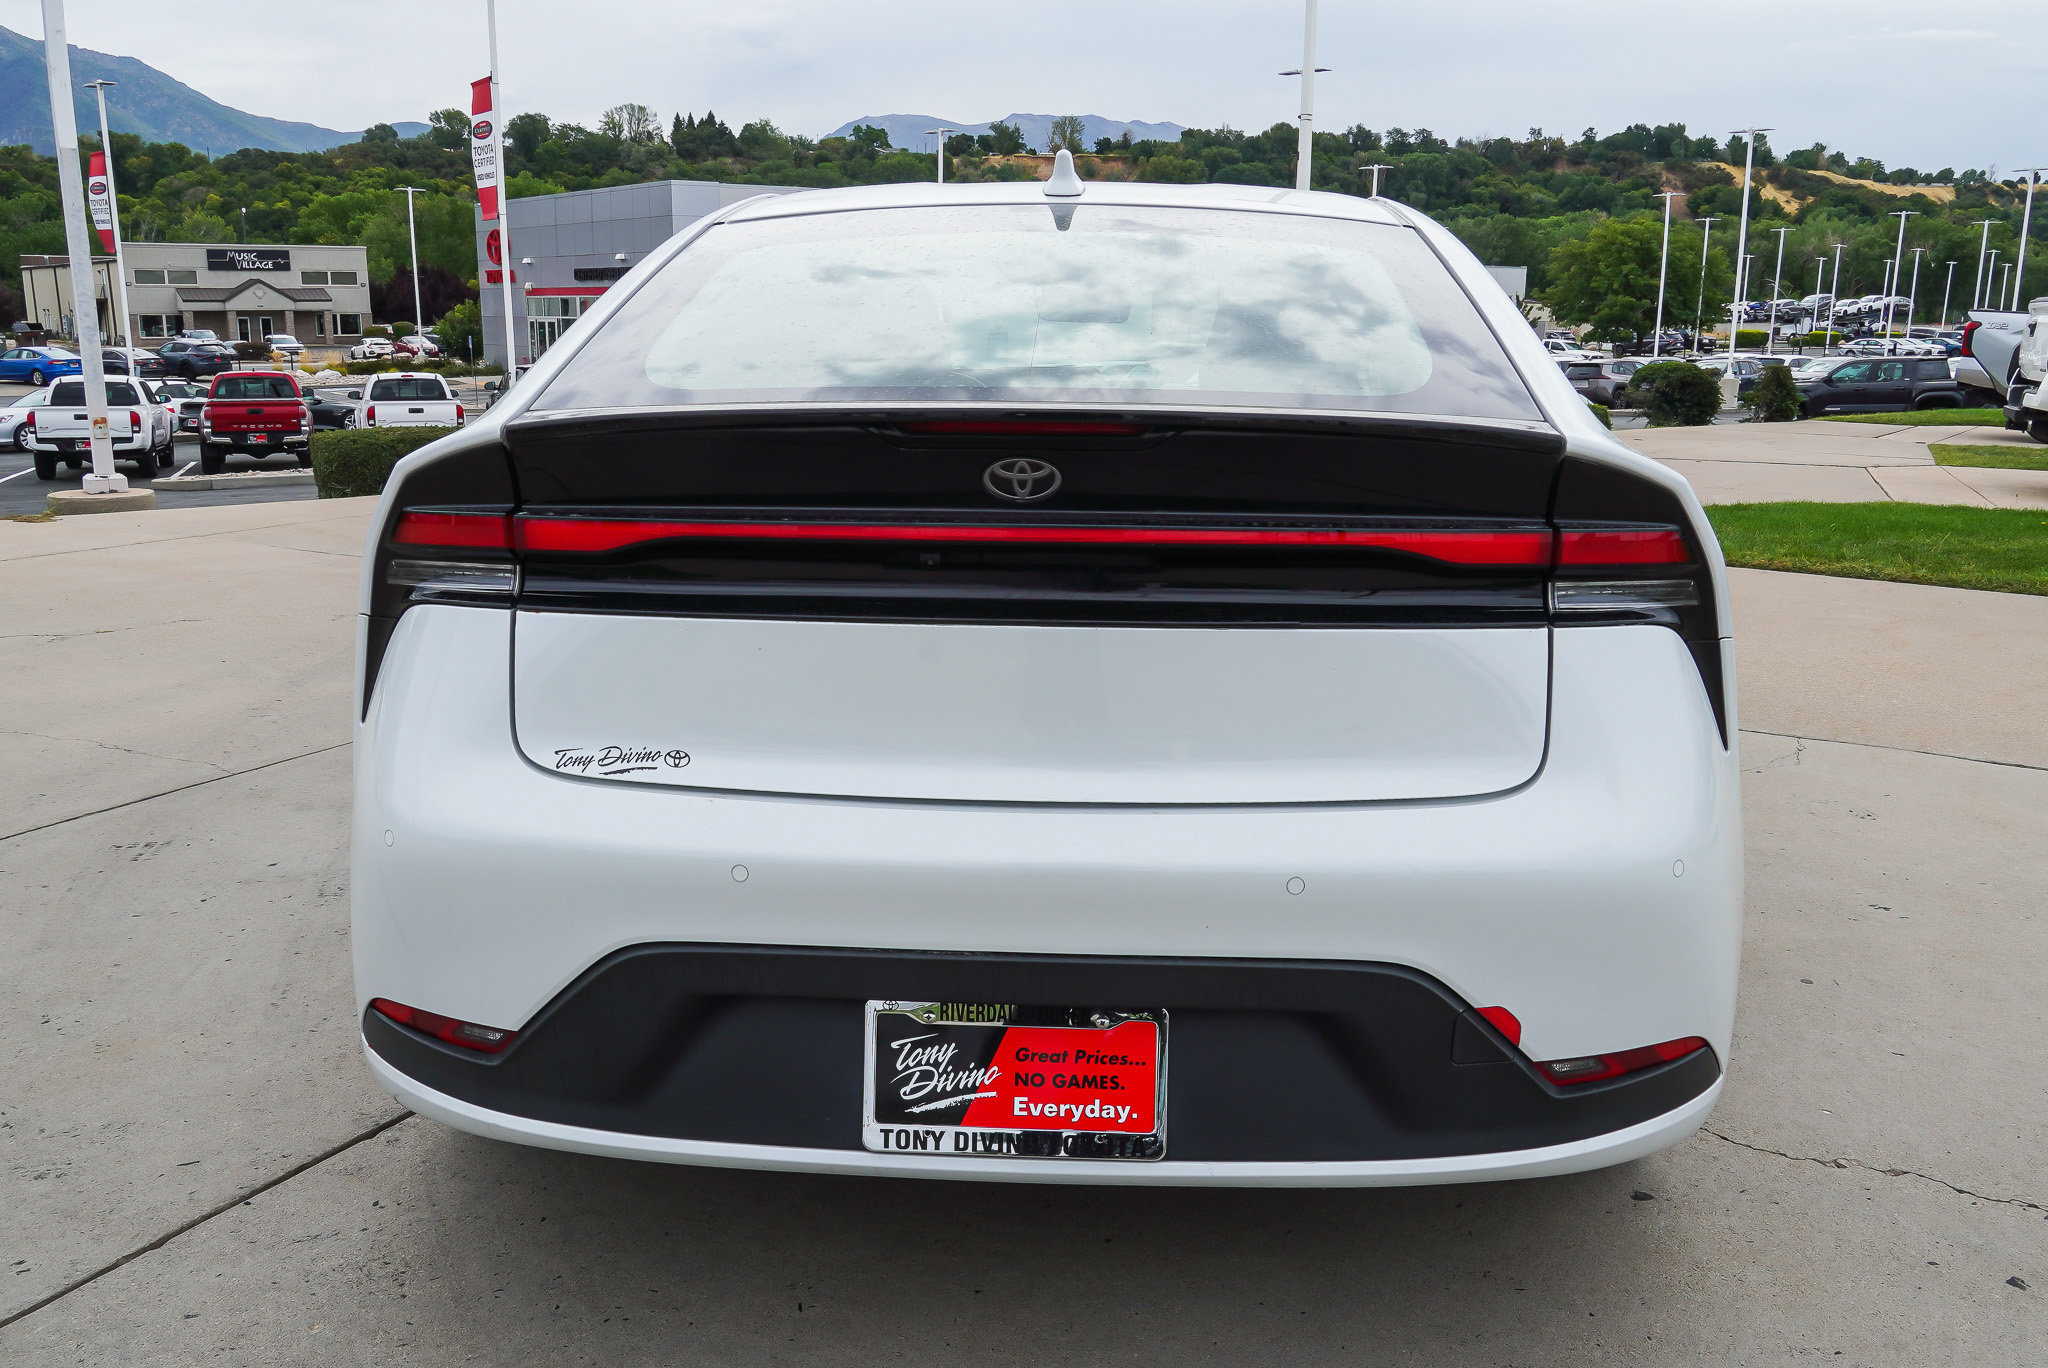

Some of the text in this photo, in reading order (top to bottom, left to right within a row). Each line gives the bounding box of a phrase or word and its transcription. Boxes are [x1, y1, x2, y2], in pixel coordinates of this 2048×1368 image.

[473, 144, 494, 157] TOYOTA
[474, 156, 495, 168] CERTIFIED
[227, 251, 258, 261] MUSIC
[235, 260, 274, 270] VILLAGE
[554, 745, 663, 773] Tony Divino
[890, 1033, 958, 1073] Tony
[1015, 1047, 1147, 1067] Great Prices...
[890, 1062, 1003, 1100] Divino
[1014, 1072, 1126, 1091] NO GAMES.
[1013, 1096, 1139, 1124] Everyday.
[879, 1128, 946, 1151] TONY
